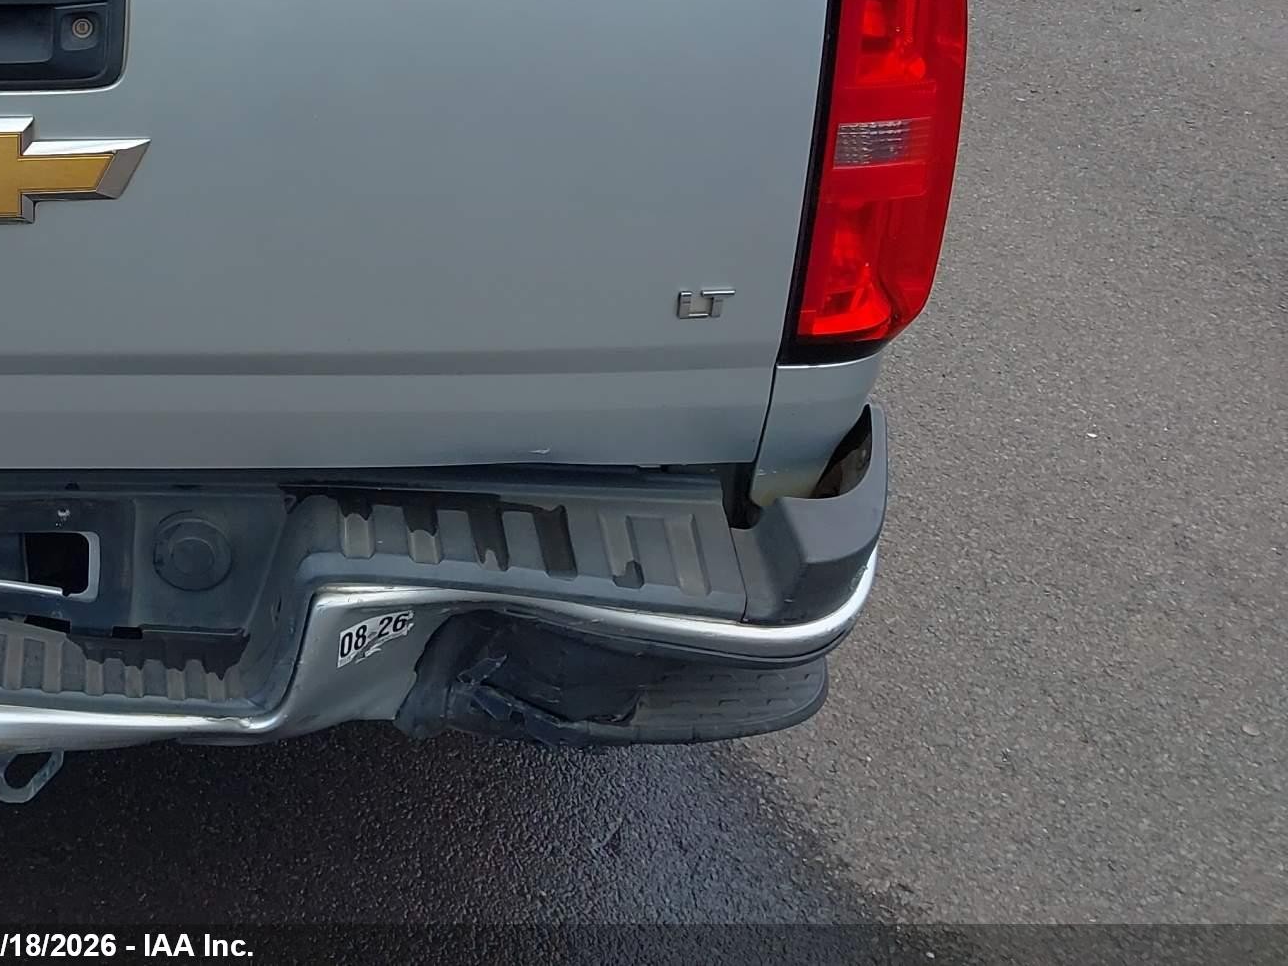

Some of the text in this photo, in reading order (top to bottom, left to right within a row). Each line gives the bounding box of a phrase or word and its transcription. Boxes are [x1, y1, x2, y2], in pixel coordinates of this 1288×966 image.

[676, 289, 736, 320] LT
[340, 613, 409, 658] 08 26
